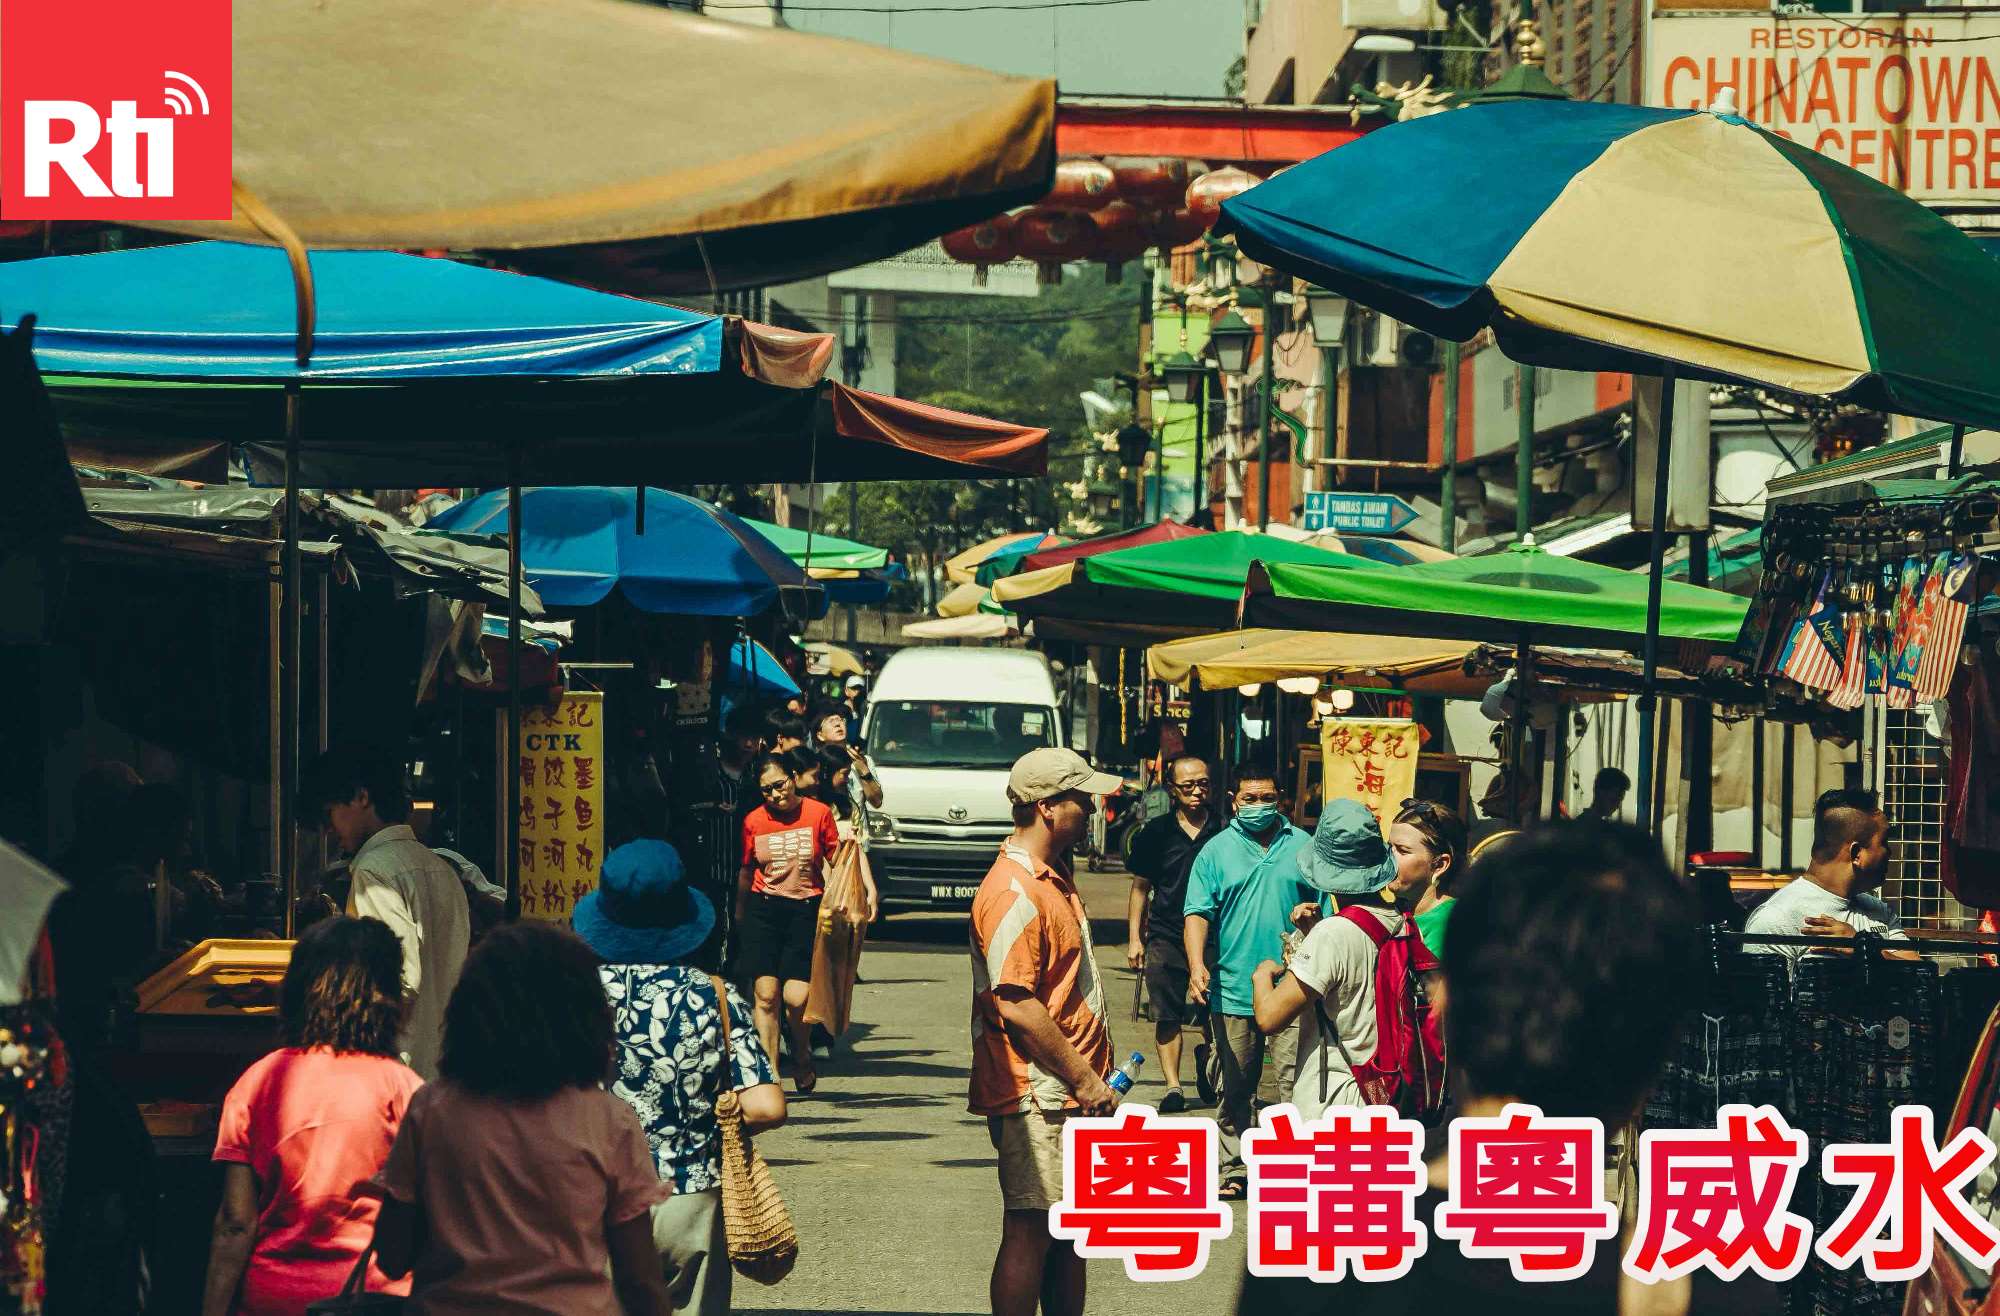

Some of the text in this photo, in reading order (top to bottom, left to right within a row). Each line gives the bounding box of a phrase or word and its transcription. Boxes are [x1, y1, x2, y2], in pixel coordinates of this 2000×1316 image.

[1750, 27, 1934, 49] RESTORAN
[1663, 55, 2000, 124] CHINATOWN
[1153, 704, 1191, 718] Snce
[526, 734, 582, 751] CTK
[931, 885, 952, 898] WWX
